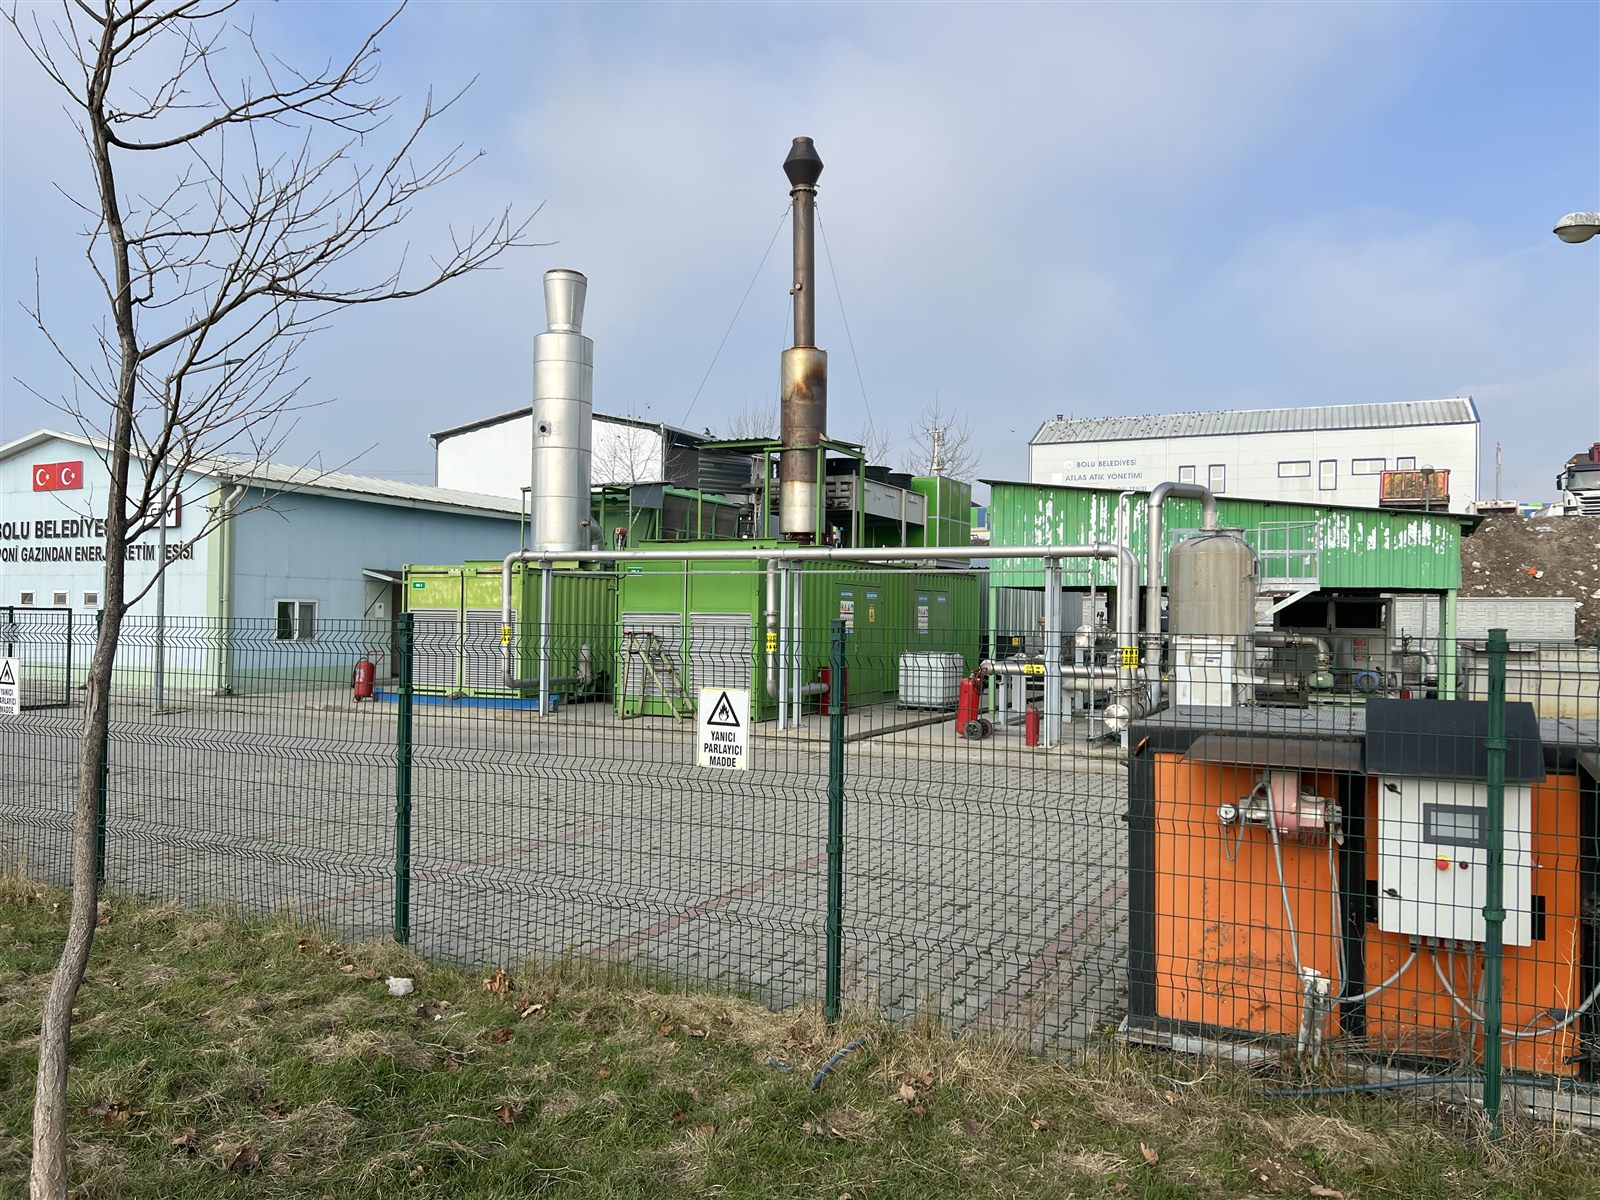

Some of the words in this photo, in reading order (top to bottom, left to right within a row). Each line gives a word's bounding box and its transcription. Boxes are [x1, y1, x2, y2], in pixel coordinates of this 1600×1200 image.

[1098, 459, 1137, 467] BELEDİYESİ
[0, 521, 30, 540] OLU
[35, 515, 108, 538] BELEDİYE
[21, 547, 72, 562] GAZINDAN
[75, 546, 107, 562] ENER
[158, 541, 194, 560] ESİSİ
[711, 731, 736, 742] YANICI
[704, 743, 742, 755] PARLAYICI
[710, 756, 736, 767] MADDE
